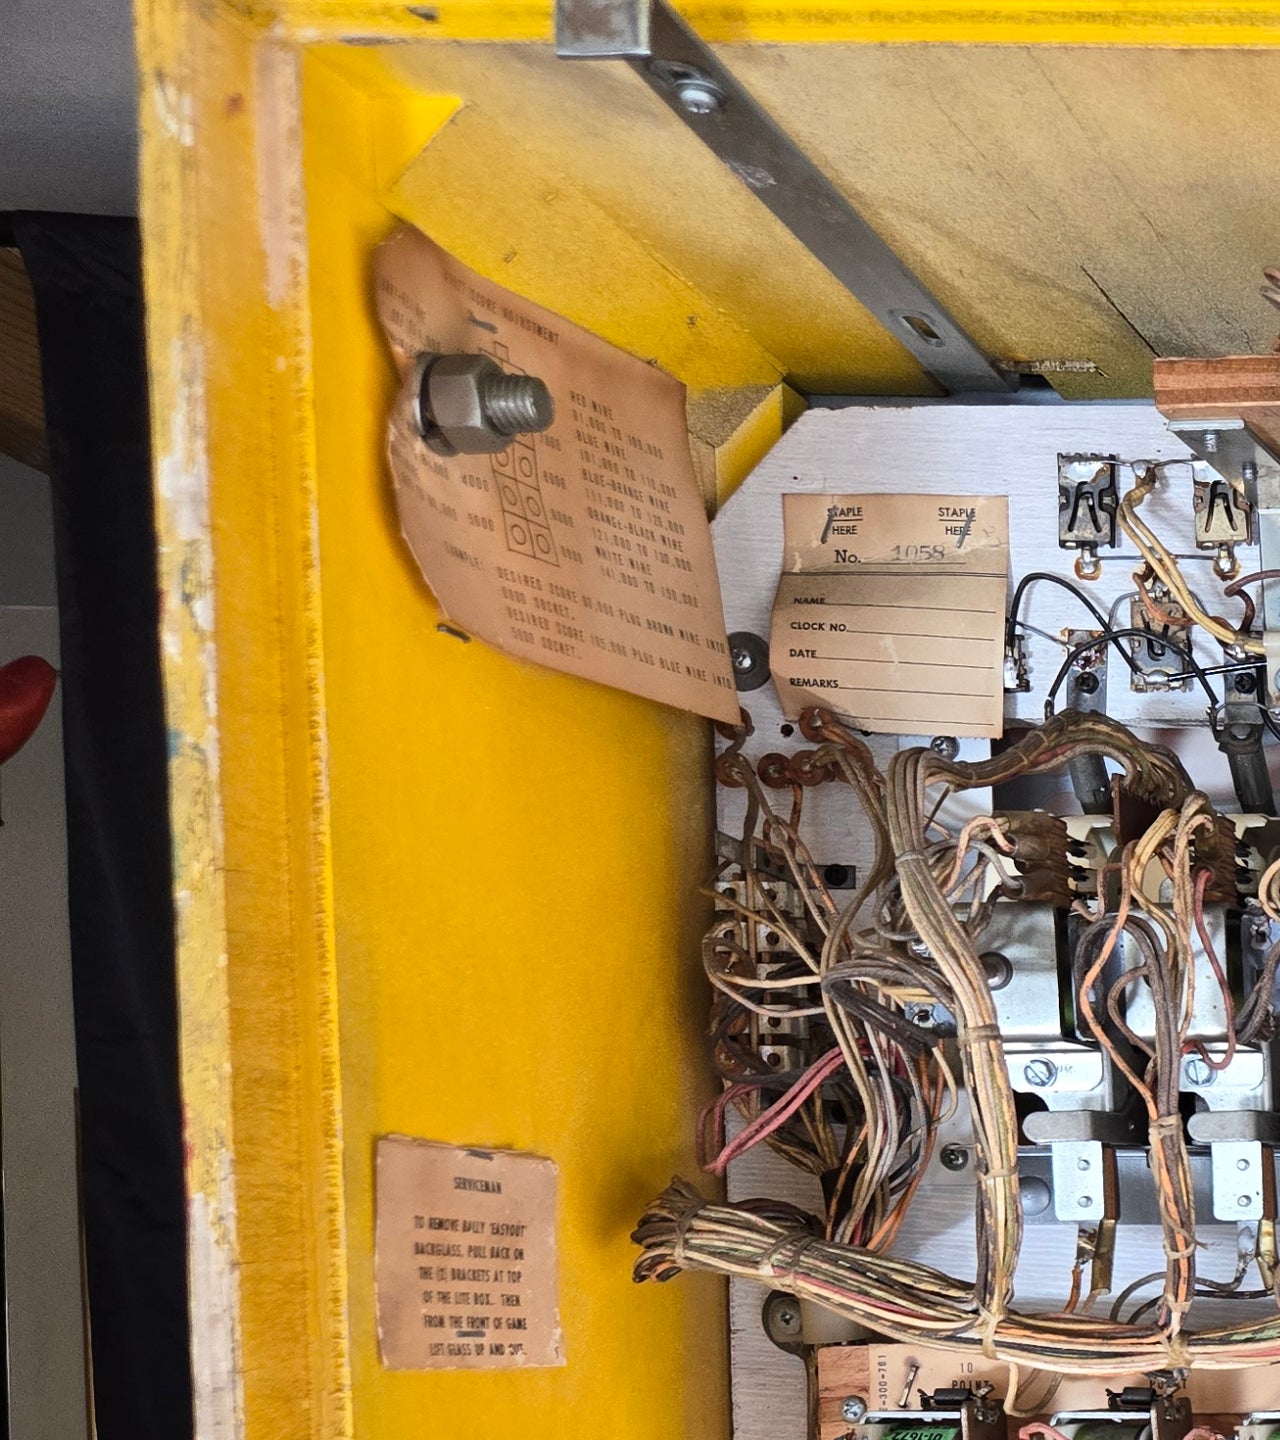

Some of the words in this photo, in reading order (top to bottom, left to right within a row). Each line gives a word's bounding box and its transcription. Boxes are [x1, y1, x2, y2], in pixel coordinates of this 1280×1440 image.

[570, 390, 587, 408] RED
[592, 400, 614, 421] WIRE
[576, 429, 599, 448] BLUE
[604, 441, 627, 460] WIRE
[625, 466, 636, 481] TO
[462, 474, 489, 492] 4000
[630, 505, 642, 519] TO
[649, 495, 671, 514] WIRE
[832, 525, 857, 535] HERE
[945, 526, 972, 536] HERE
[636, 543, 648, 557] TO
[661, 535, 684, 553] WIRE
[595, 545, 624, 566] WHITE
[629, 558, 653, 576] WIRE
[834, 549, 861, 564] No.
[644, 580, 655, 594] TO
[793, 597, 826, 605] NAME
[497, 566, 543, 591] DESIRED
[549, 583, 578, 603] SCORE
[619, 608, 642, 627] PLUG
[646, 618, 674, 636] BROWN
[679, 628, 701, 646] WIRE
[706, 638, 726, 654] INTO
[790, 621, 825, 631] CLOCK
[507, 606, 550, 630] DESIRED
[556, 622, 585, 643] SCORE
[632, 648, 655, 666] PLUG
[659, 657, 682, 674] BLUE
[686, 666, 708, 683] WIRE
[712, 673, 732, 690] INTO
[789, 649, 817, 658] DATE
[789, 678, 839, 689] REMARKS
[453, 1177, 502, 1194] SERVICEMAN
[414, 1215, 425, 1229] TO
[429, 1217, 459, 1232] REMOVE
[462, 1220, 486, 1234] BALLY
[467, 1245, 487, 1259] PULL
[490, 1246, 510, 1260] BACK
[419, 1266, 433, 1280] THE
[451, 1268, 490, 1282] BRACKETS
[493, 1270, 504, 1283] AT
[507, 1270, 522, 1283] TOP
[422, 1290, 433, 1303] OF
[437, 1291, 451, 1304] THE
[455, 1292, 470, 1305] LITE
[501, 1294, 521, 1306] THEN
[424, 1315, 445, 1328] FROM
[449, 1316, 463, 1328] THE
[467, 1316, 491, 1329] FRONT
[493, 1317, 503, 1329] OF
[506, 1317, 527, 1330] GAME
[429, 1343, 445, 1356] LIFT
[447, 1343, 471, 1356] GLASS
[475, 1343, 484, 1355] UP
[490, 1343, 505, 1355] AND
[960, 1362, 973, 1373] 10
